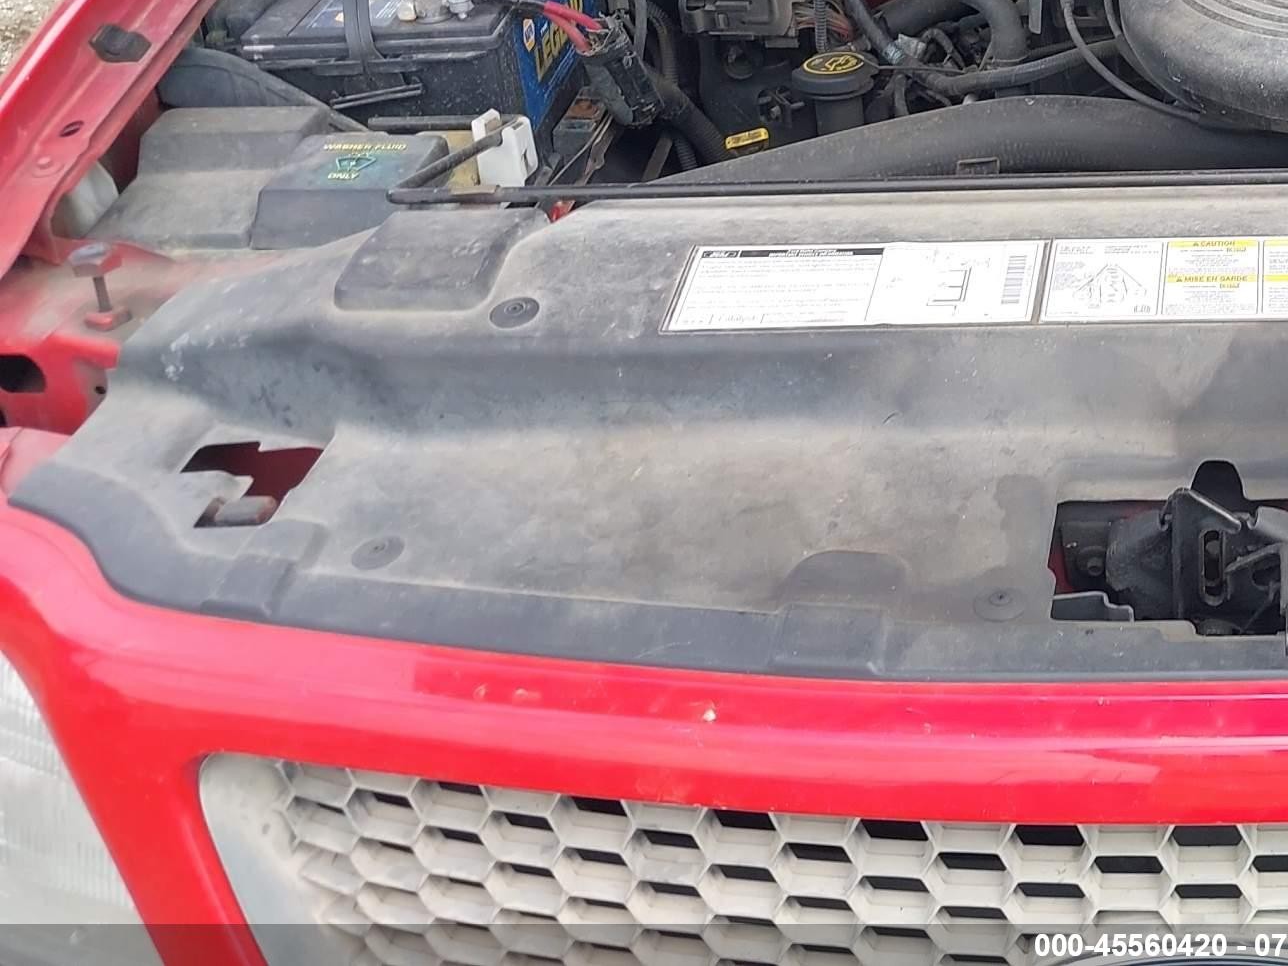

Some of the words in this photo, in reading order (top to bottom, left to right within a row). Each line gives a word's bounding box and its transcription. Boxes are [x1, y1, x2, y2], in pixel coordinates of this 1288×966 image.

[374, 143, 408, 151] FLUID
[1183, 275, 1205, 283] MISE
[1219, 274, 1248, 282] GARDE
